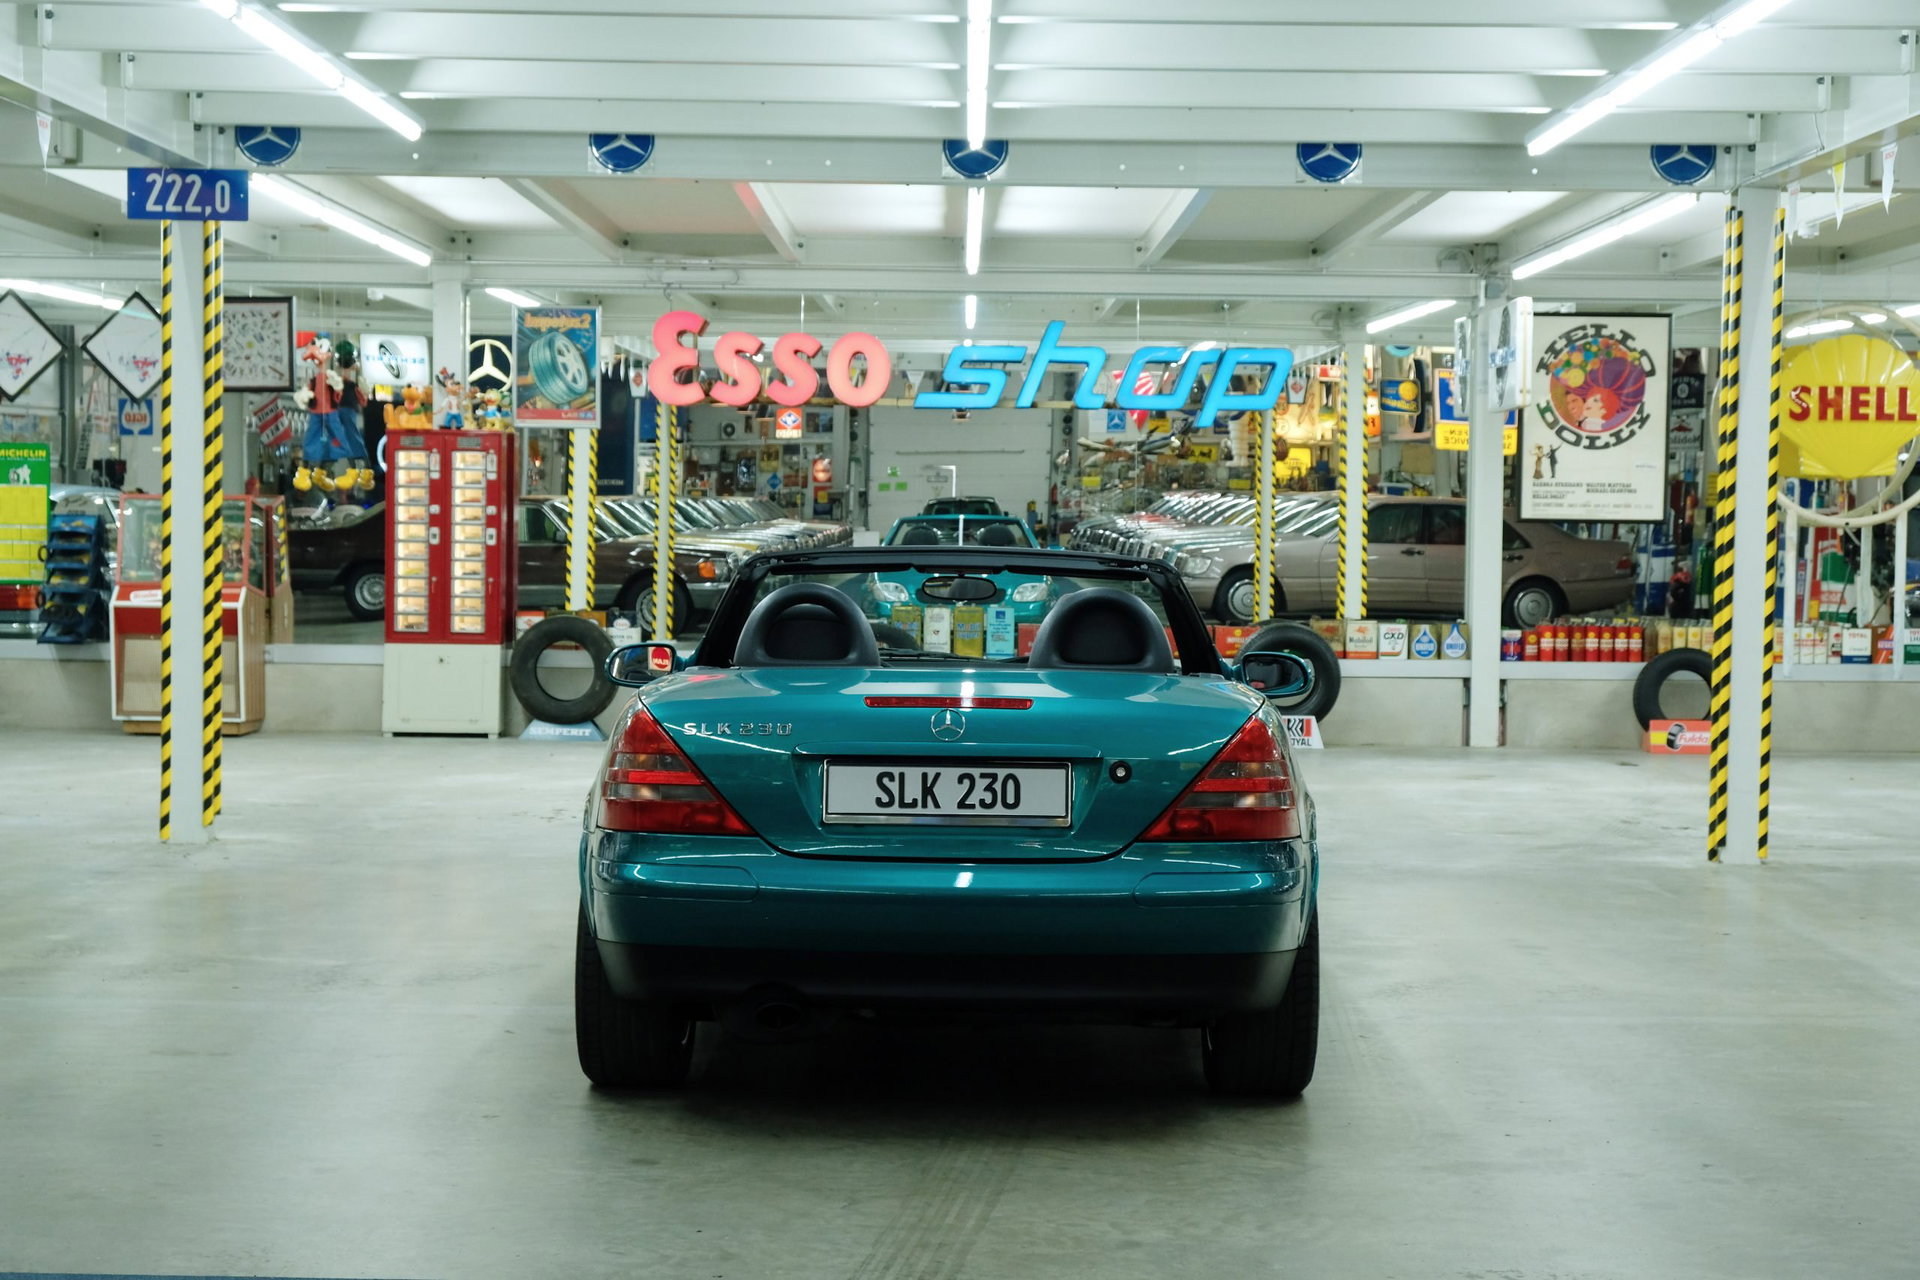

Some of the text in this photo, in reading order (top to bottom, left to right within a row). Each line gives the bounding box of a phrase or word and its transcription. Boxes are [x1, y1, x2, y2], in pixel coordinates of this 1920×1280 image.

[145, 173, 231, 217] 222,0
[1536, 323, 1656, 377] HELLO
[914, 320, 1294, 428] shop
[1789, 385, 1917, 422] SHELL
[1536, 400, 1651, 450] DOLLY
[528, 727, 592, 736] SEMPERIT
[683, 722, 792, 735] SLK 230
[1679, 733, 1709, 743] Fulda
[874, 771, 1022, 810] SLK 230
